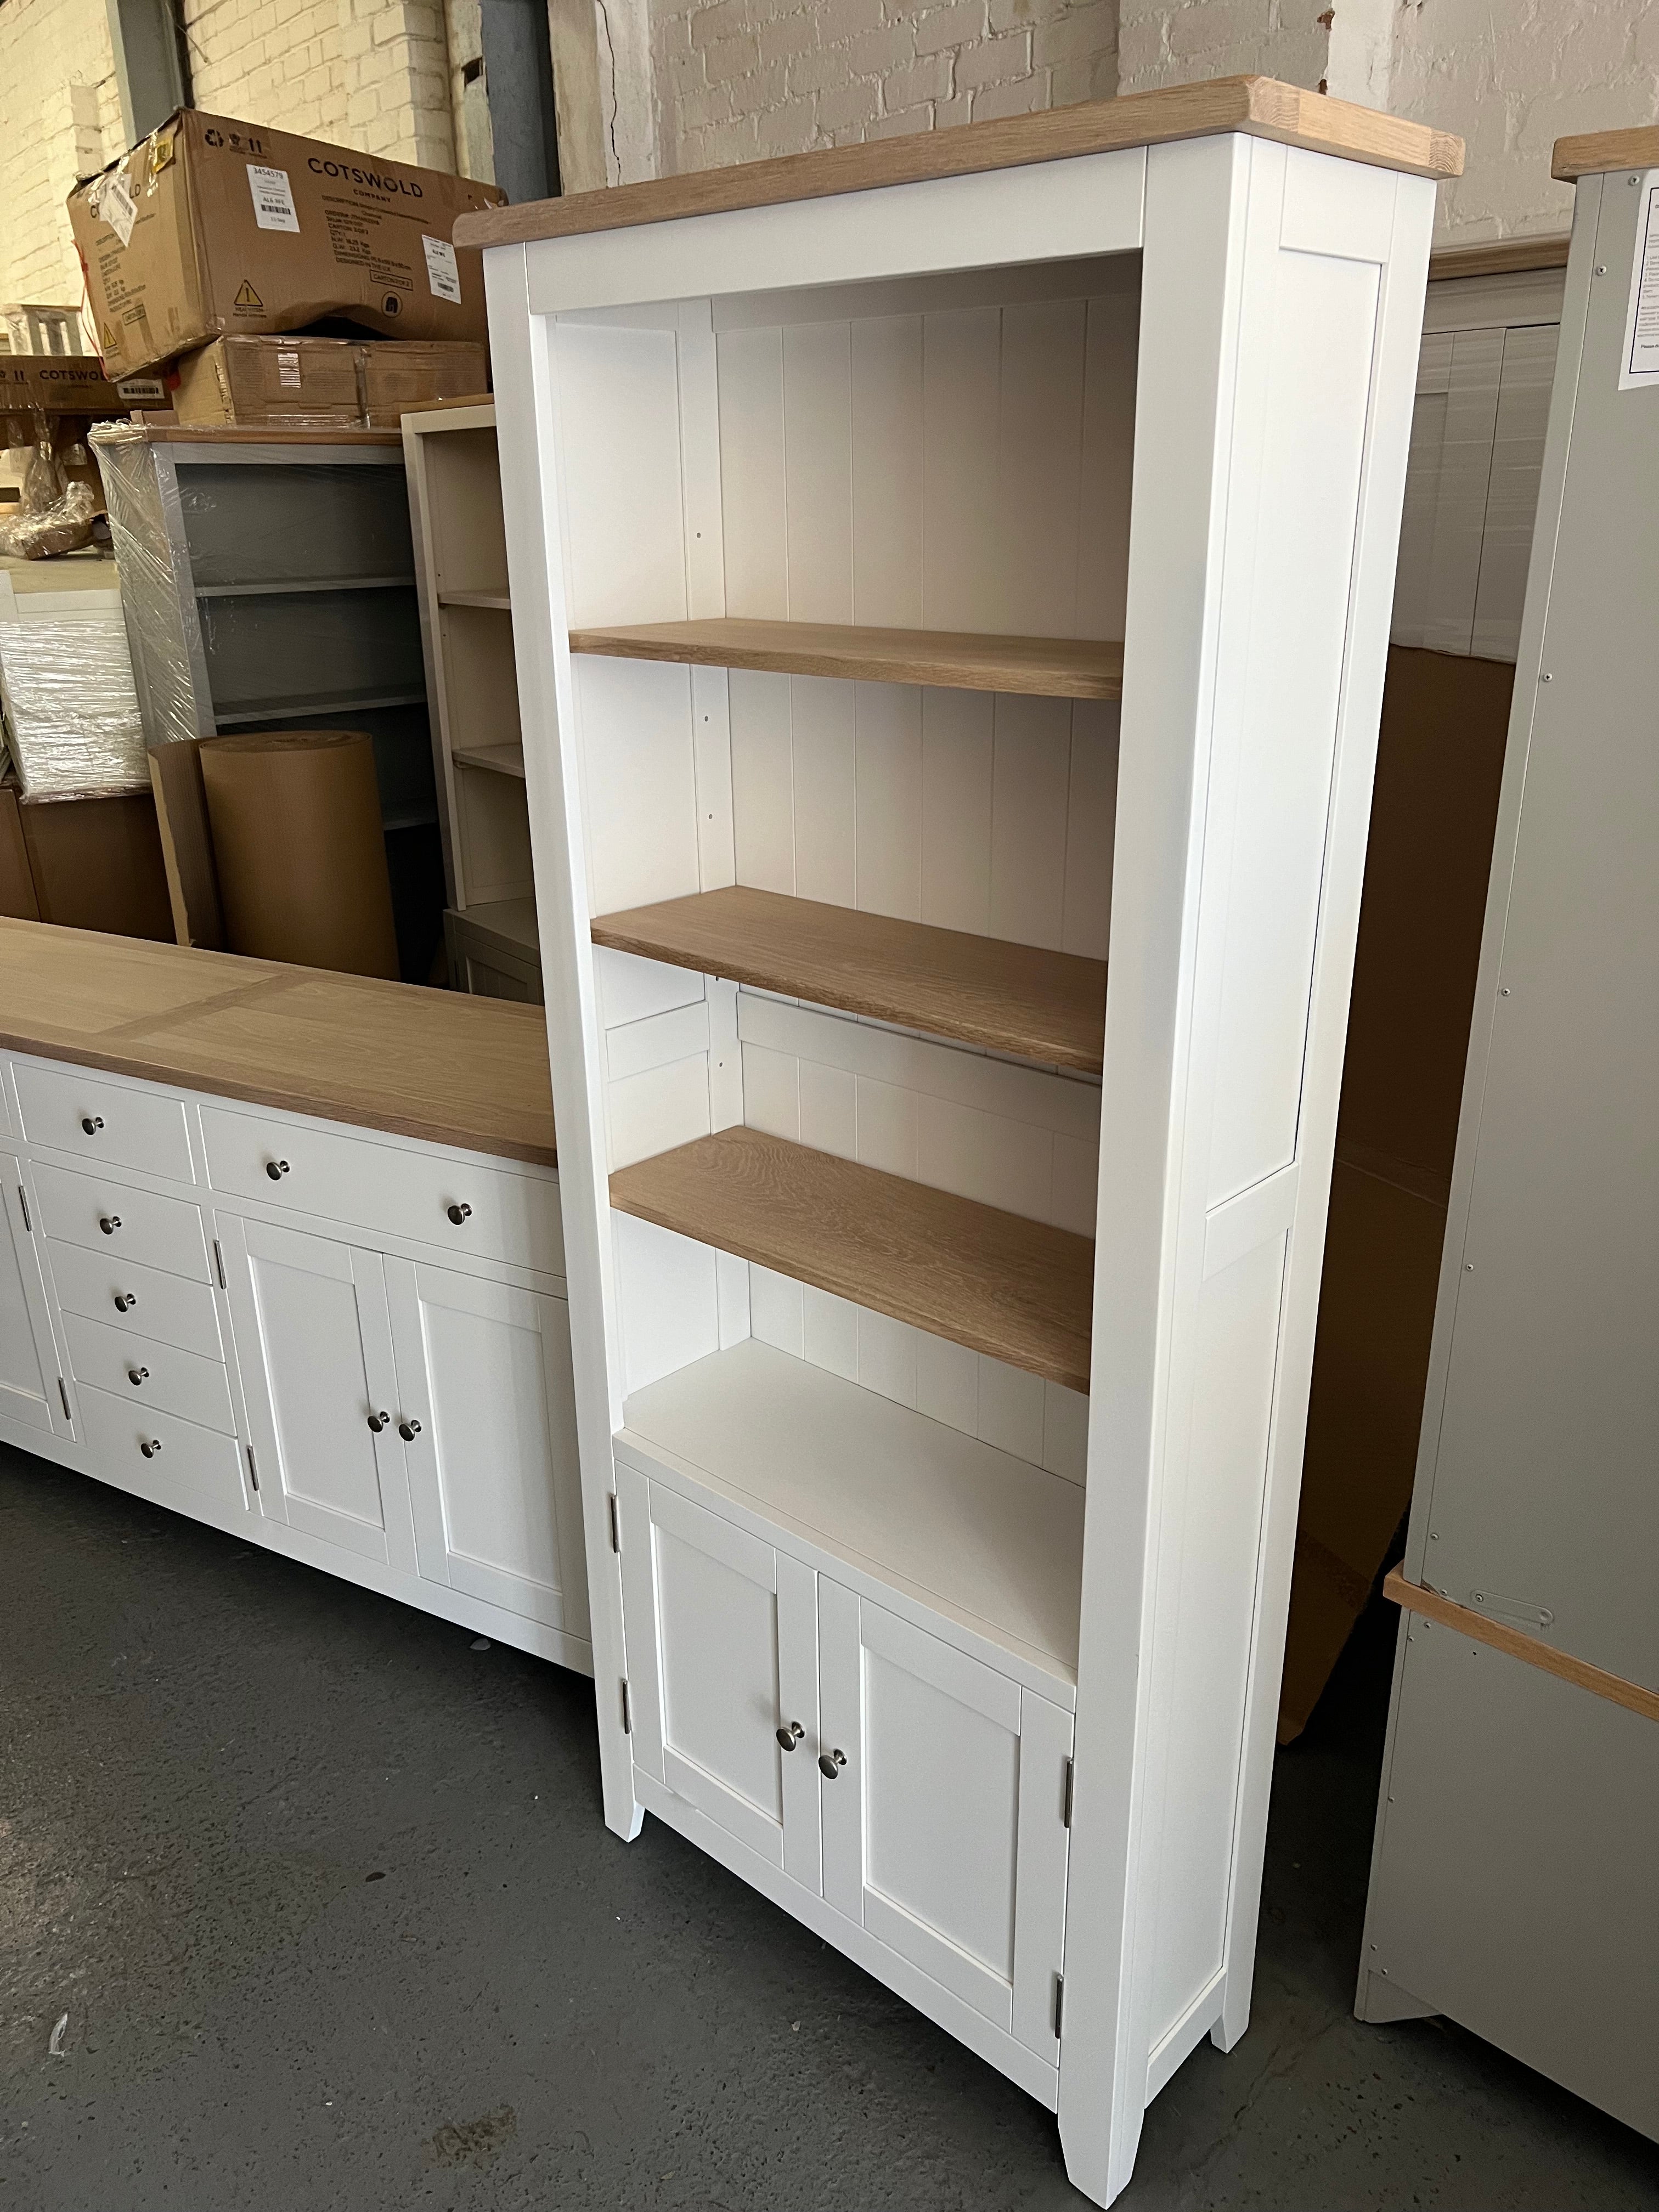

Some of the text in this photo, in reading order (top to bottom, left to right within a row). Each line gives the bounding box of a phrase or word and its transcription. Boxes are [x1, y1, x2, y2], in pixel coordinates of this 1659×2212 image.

[308, 157, 423, 198] COTSWOLD
[353, 189, 391, 203] COMPANY
[39, 369, 107, 381] COTSWOL
